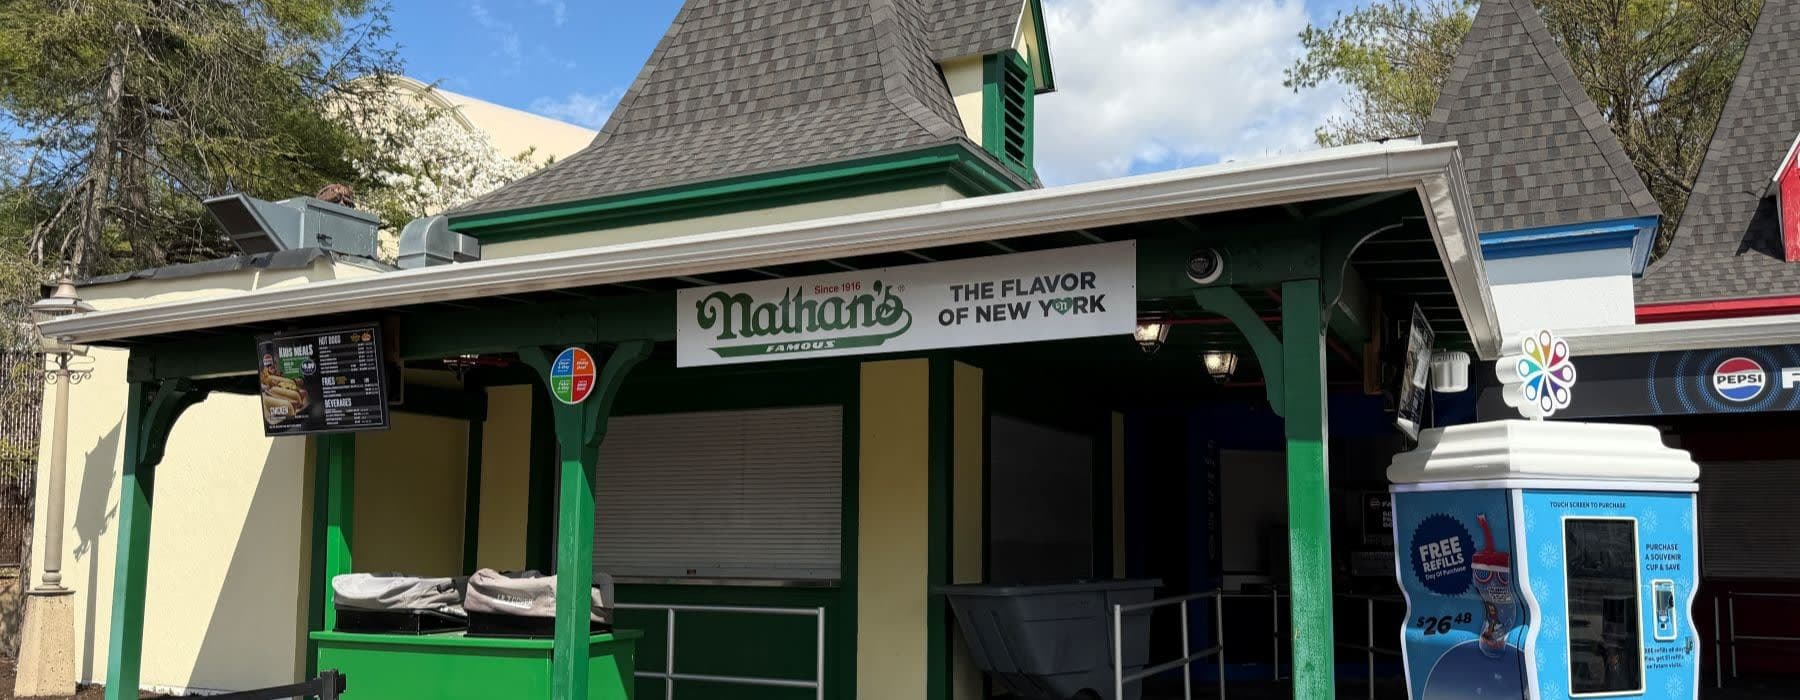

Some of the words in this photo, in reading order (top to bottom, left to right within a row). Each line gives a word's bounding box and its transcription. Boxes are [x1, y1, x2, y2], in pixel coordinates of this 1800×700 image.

[815, 284, 839, 295] Since
[842, 282, 861, 292] 1916
[950, 282, 994, 302] THE
[1001, 272, 1096, 298] FLAVOR
[696, 279, 905, 340] Nathan's
[938, 307, 968, 326] OF
[976, 301, 1031, 323] NEW
[278, 346, 293, 358] KIDS
[293, 343, 314, 357] MEALS
[766, 340, 836, 352] FAMOUS
[322, 376, 336, 386] FRIES
[1716, 374, 1762, 384] PEPSI
[324, 397, 352, 408] BEVERAGES
[1419, 536, 1462, 562] FREE
[1645, 543, 1679, 551] PURCHASE
[1423, 553, 1465, 573] REFILLS
[1650, 553, 1682, 561] SOUVENIR
[1425, 572, 1435, 581] Day
[1442, 566, 1466, 577] Purchase
[1646, 563, 1659, 571] CUP
[1665, 563, 1681, 571] SAVE
